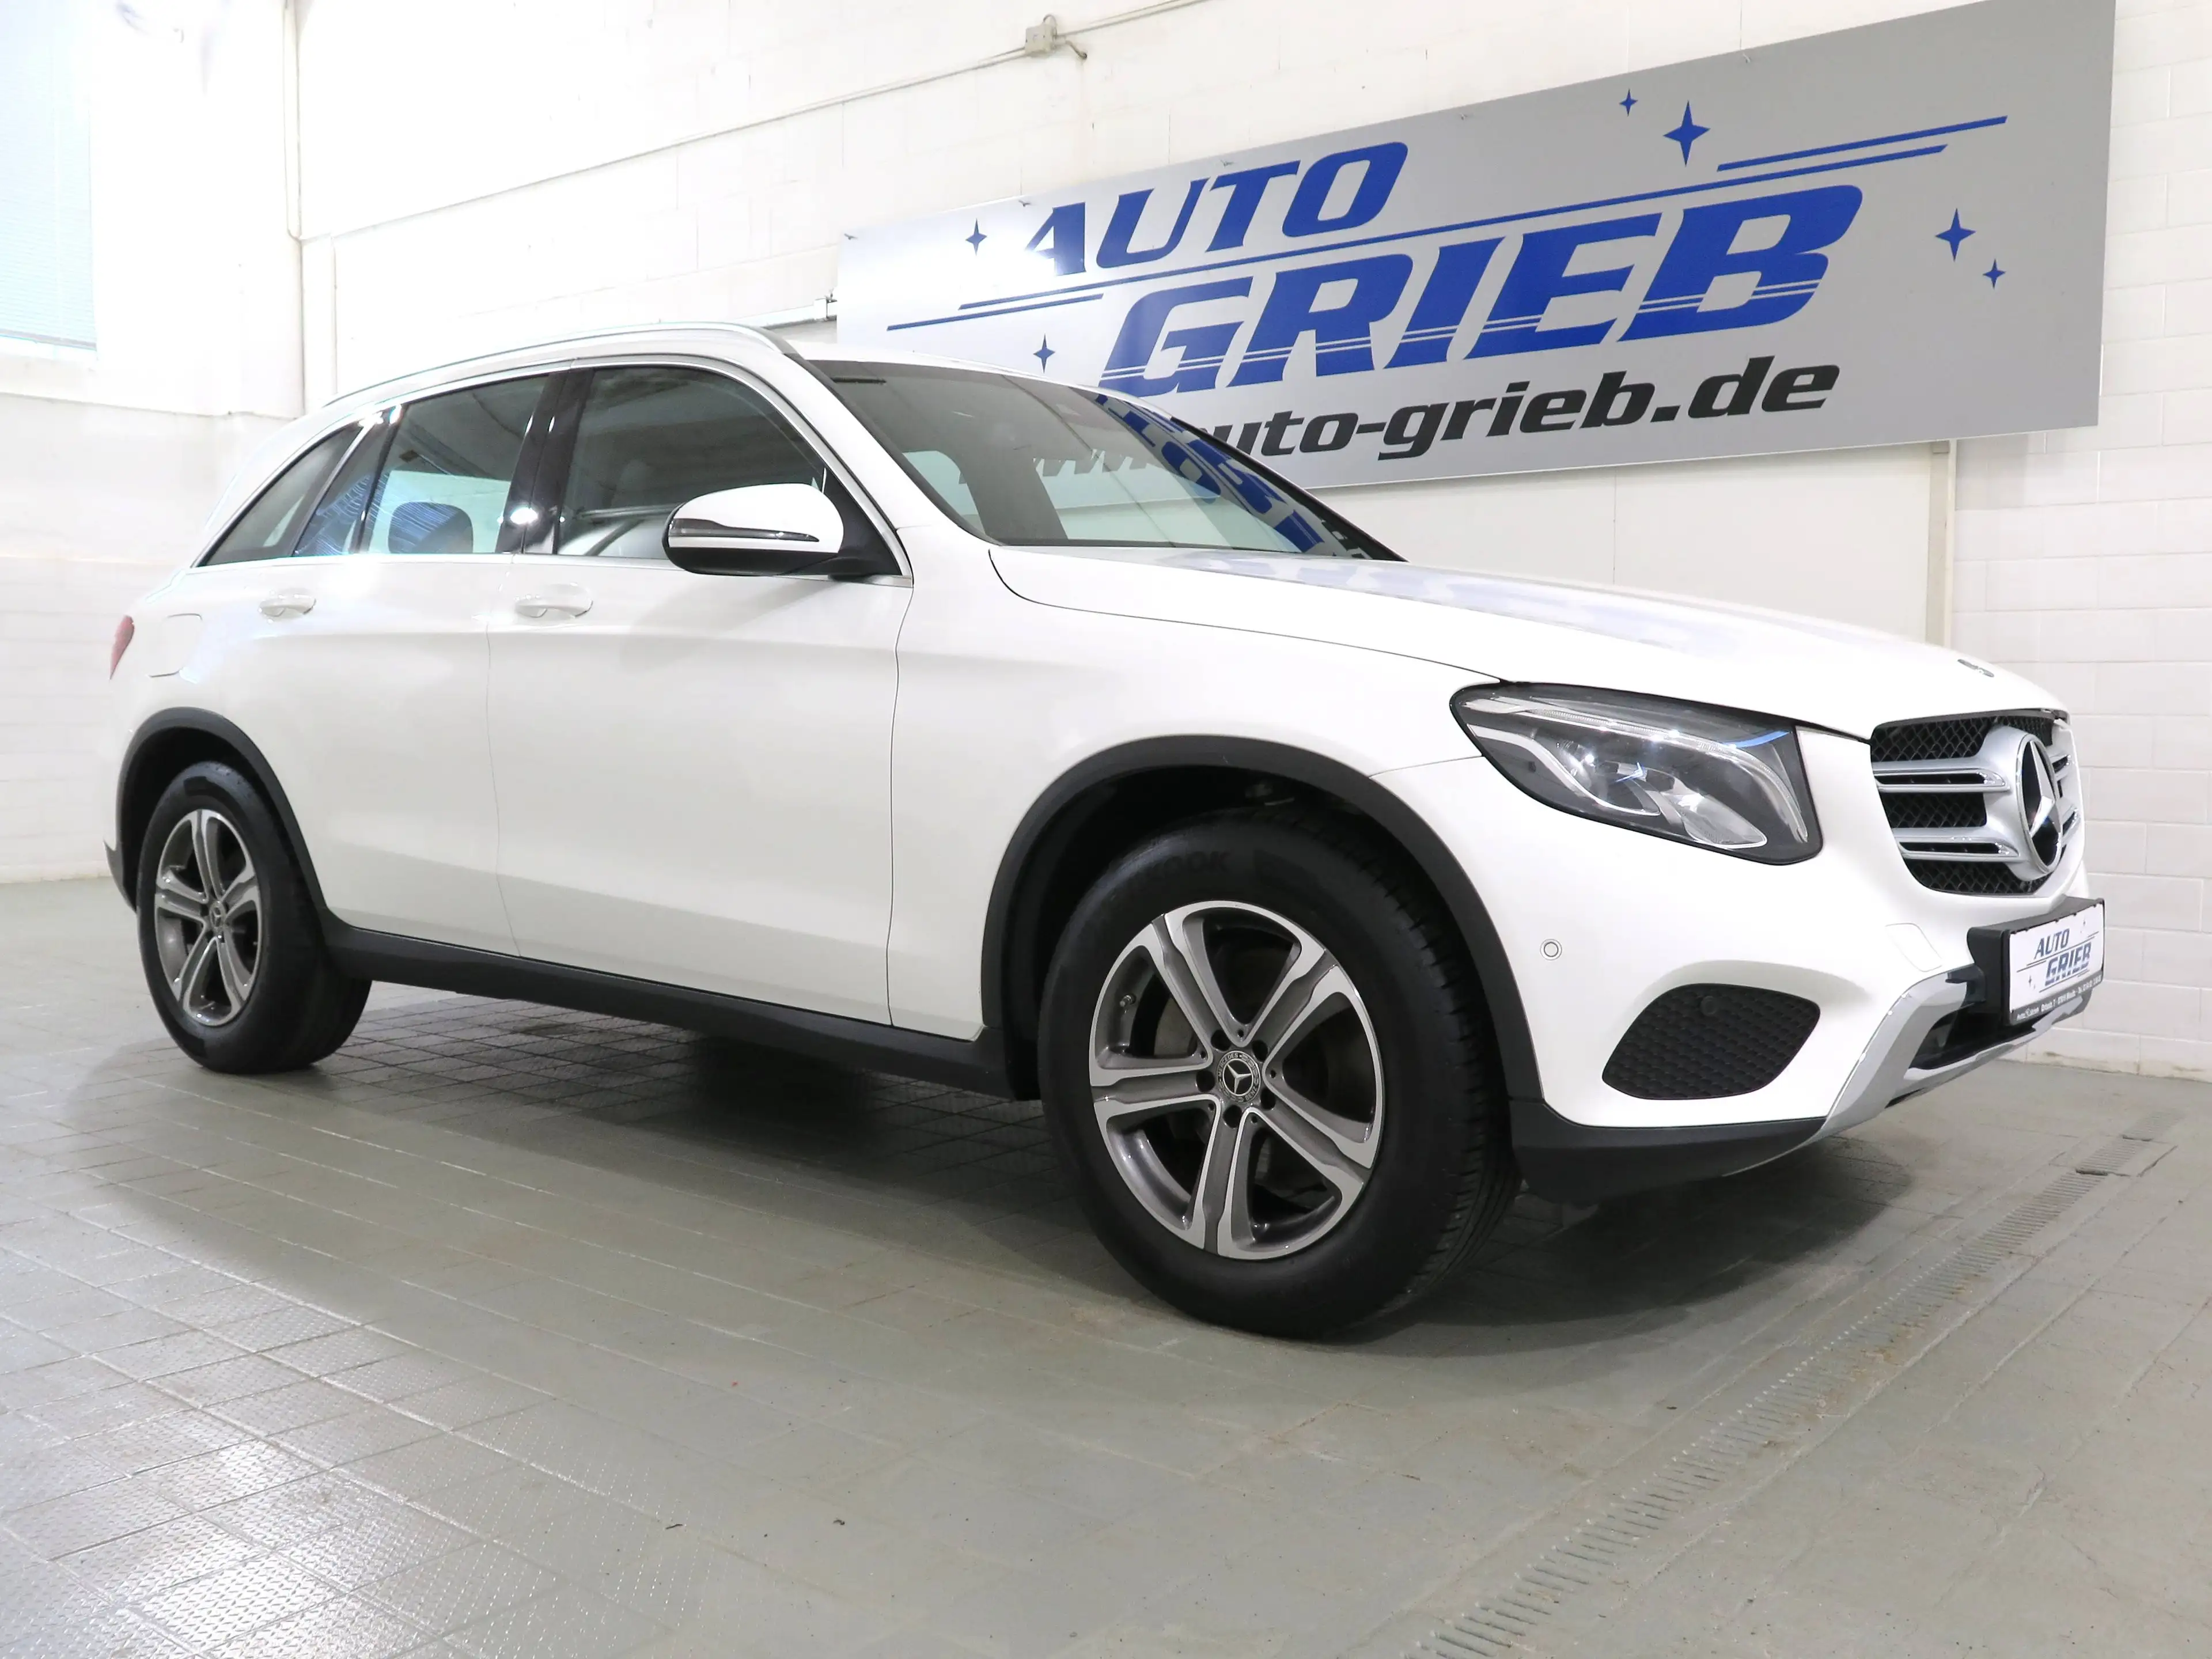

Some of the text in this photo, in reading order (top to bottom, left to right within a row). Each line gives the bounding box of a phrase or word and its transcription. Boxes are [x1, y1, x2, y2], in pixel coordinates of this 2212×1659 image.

[1027, 141, 1409, 275] AUTO
[1098, 185, 1863, 397] GRIEB
[1200, 355, 1840, 461] uto-grieb.de
[2034, 928, 2070, 960] AUTO
[2044, 942, 2092, 987] GRIEB
